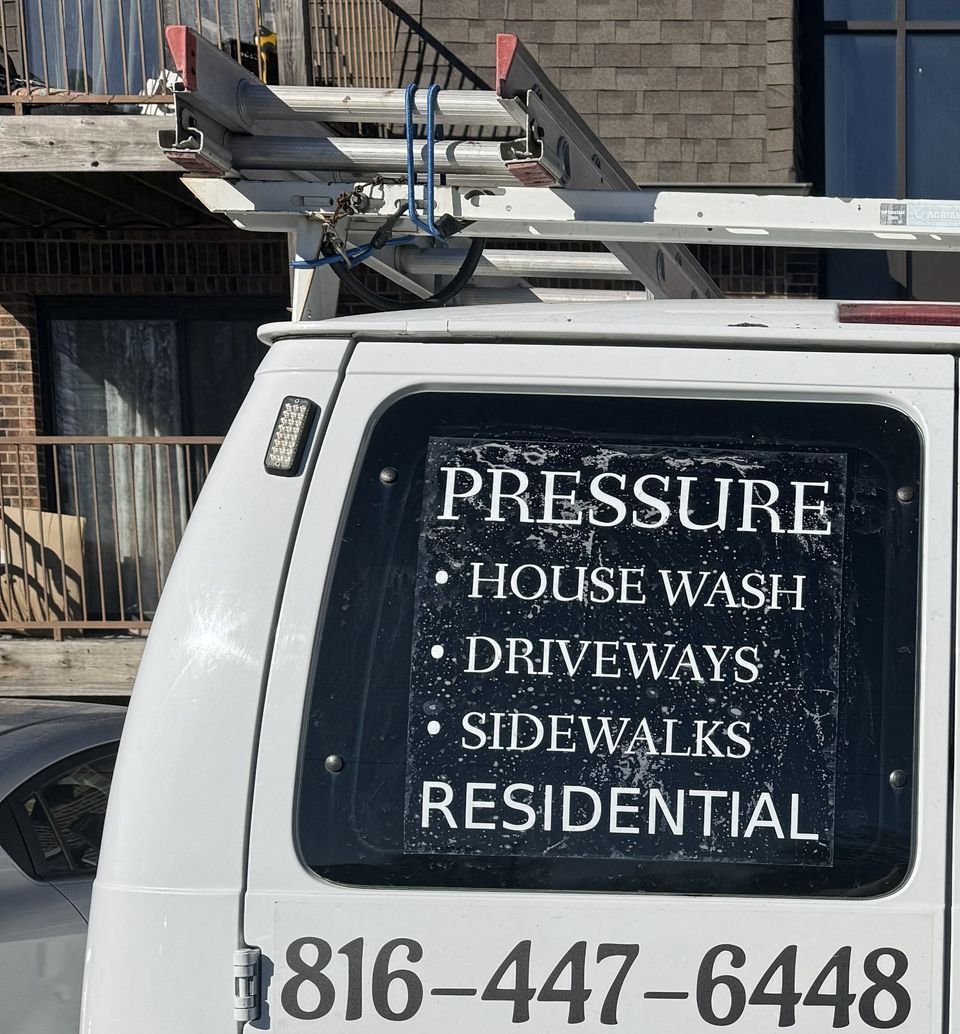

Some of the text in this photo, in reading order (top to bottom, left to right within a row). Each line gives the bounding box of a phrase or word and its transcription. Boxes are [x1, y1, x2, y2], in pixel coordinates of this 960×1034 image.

[437, 466, 832, 536] PRESSURE
[468, 562, 806, 611] HOUSE WASH
[464, 636, 760, 683] DRIVEWAYS
[461, 712, 751, 758] SIDEWALKS
[421, 781, 819, 841] RESIDENTIAL
[281, 936, 912, 1029] 816-447-6448
